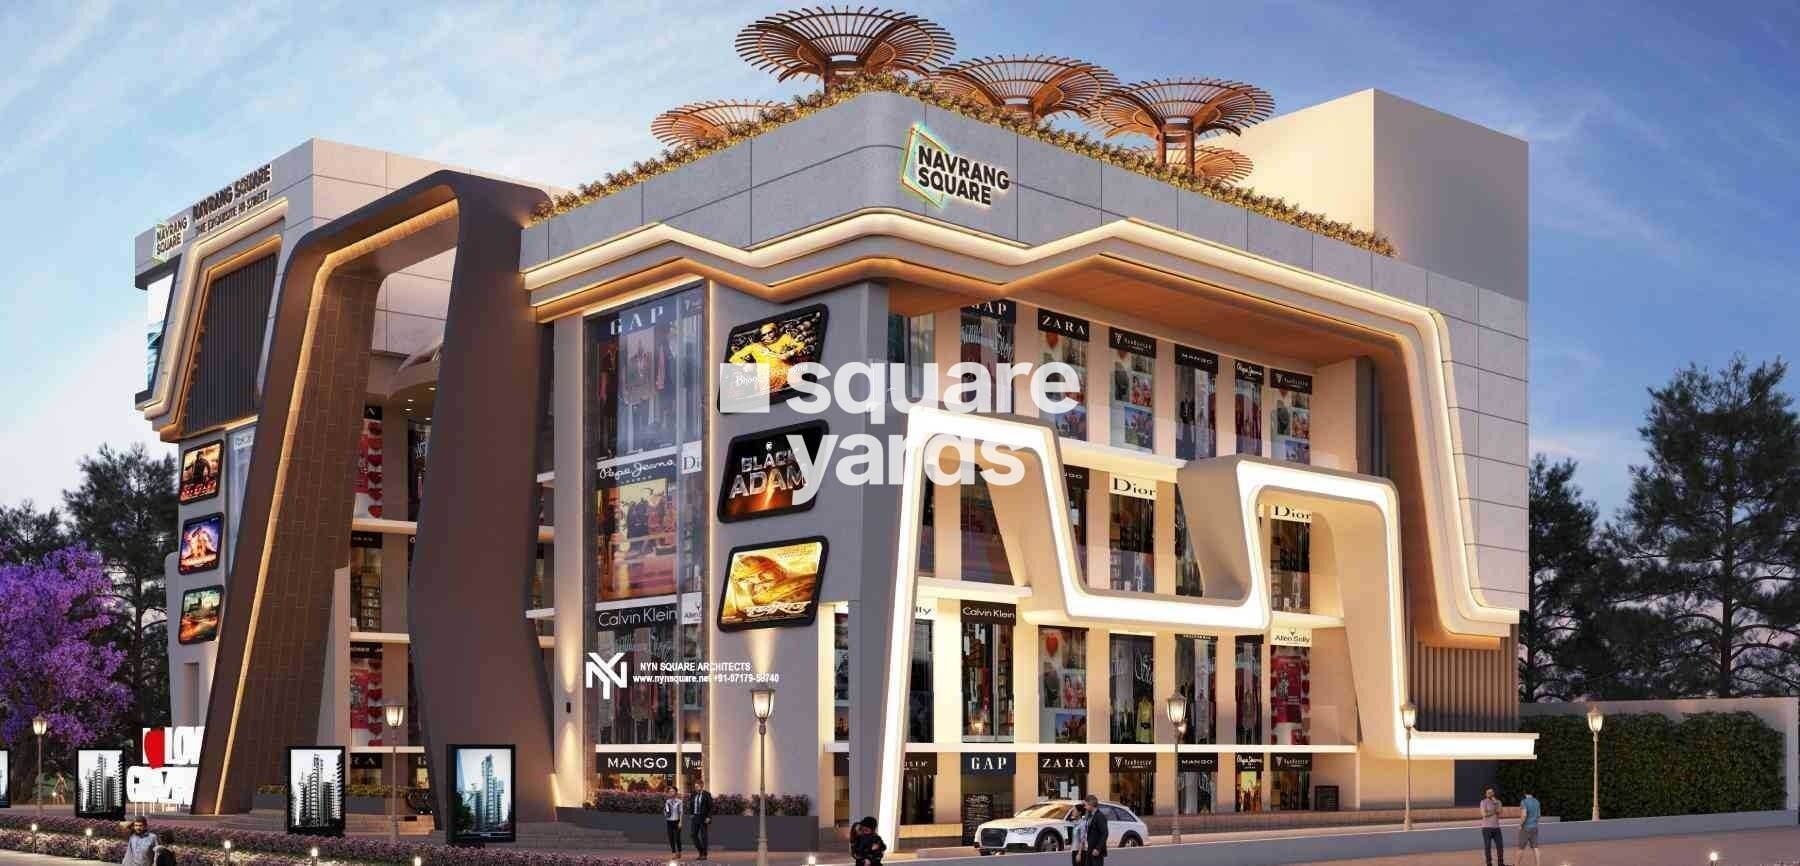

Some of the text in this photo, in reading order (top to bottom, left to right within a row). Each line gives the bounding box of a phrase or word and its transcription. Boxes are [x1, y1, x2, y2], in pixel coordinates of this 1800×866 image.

[918, 145, 1010, 190] NAVRANG
[234, 163, 271, 198] SQUARE
[918, 166, 991, 205] SQUARE
[156, 216, 187, 241] NAVRANG
[156, 233, 182, 254] SQUARE
[610, 305, 664, 336] GAP
[1042, 315, 1087, 336] ZARA
[741, 450, 798, 473] BLACK
[729, 465, 808, 499] ADAM
[1113, 477, 1157, 496] Dior
[1274, 505, 1312, 520] Dior
[598, 606, 678, 627] Calvin Klein
[962, 606, 1015, 619] Calvin Klein
[607, 757, 668, 769] MANGO
[971, 757, 1007, 770] GAP
[1041, 758, 1086, 768] ZARA
